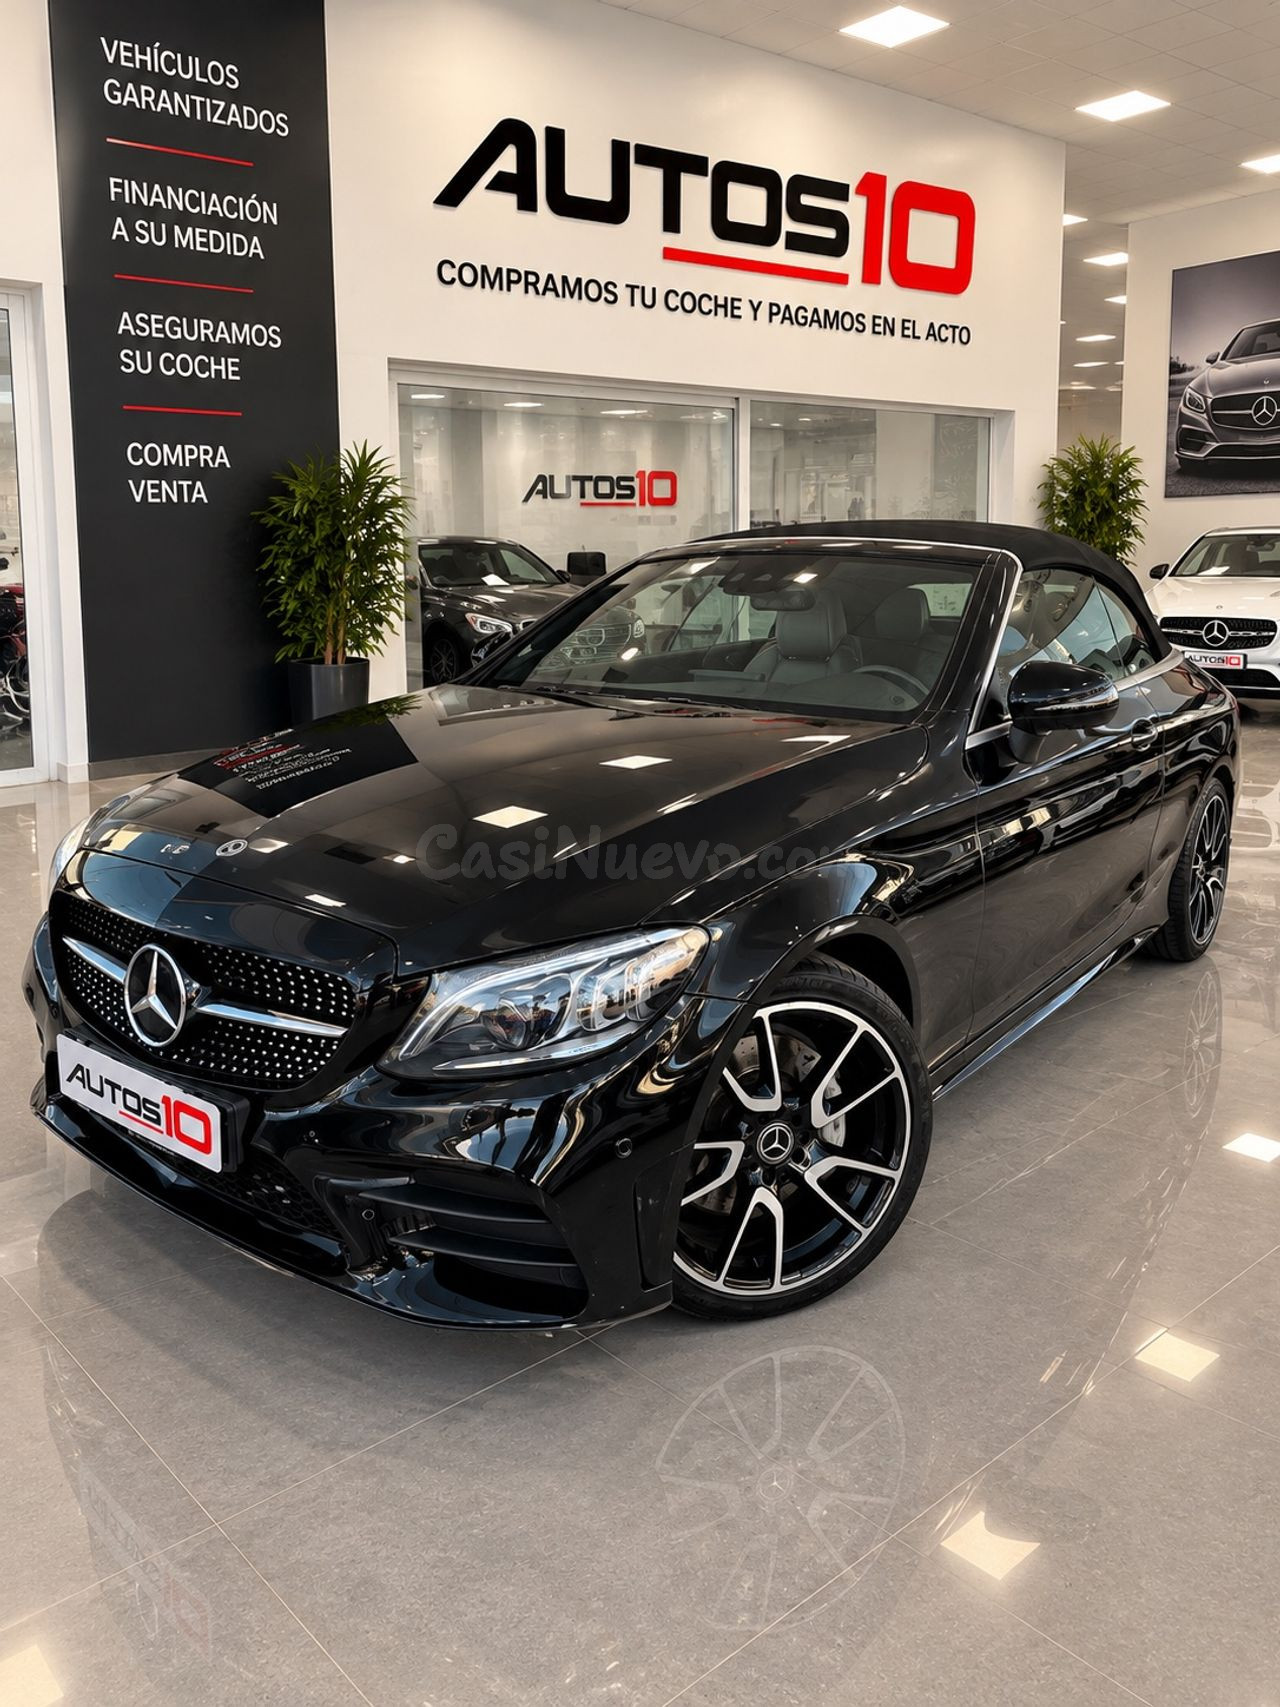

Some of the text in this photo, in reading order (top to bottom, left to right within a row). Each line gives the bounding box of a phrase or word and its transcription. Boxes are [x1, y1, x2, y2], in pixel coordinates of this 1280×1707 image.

[100, 36, 240, 90] VEHÍCULOS
[103, 78, 289, 137] GARANTIZADOS
[109, 176, 278, 226] FINANCIACIÓN
[432, 117, 976, 296] AUTOS10
[111, 216, 264, 260] A SU MEDIDA
[436, 259, 972, 346] COMPRAMOS TU COCHE Y PAGAMOS EN EL ACTO
[117, 311, 282, 349] ASEGURAMOS
[119, 348, 241, 381] SU COCHE
[126, 442, 231, 468] COMPRA
[127, 479, 209, 504] VENTA
[522, 470, 678, 507] AUTOS10
[66, 1063, 213, 1155] AUTOS10
